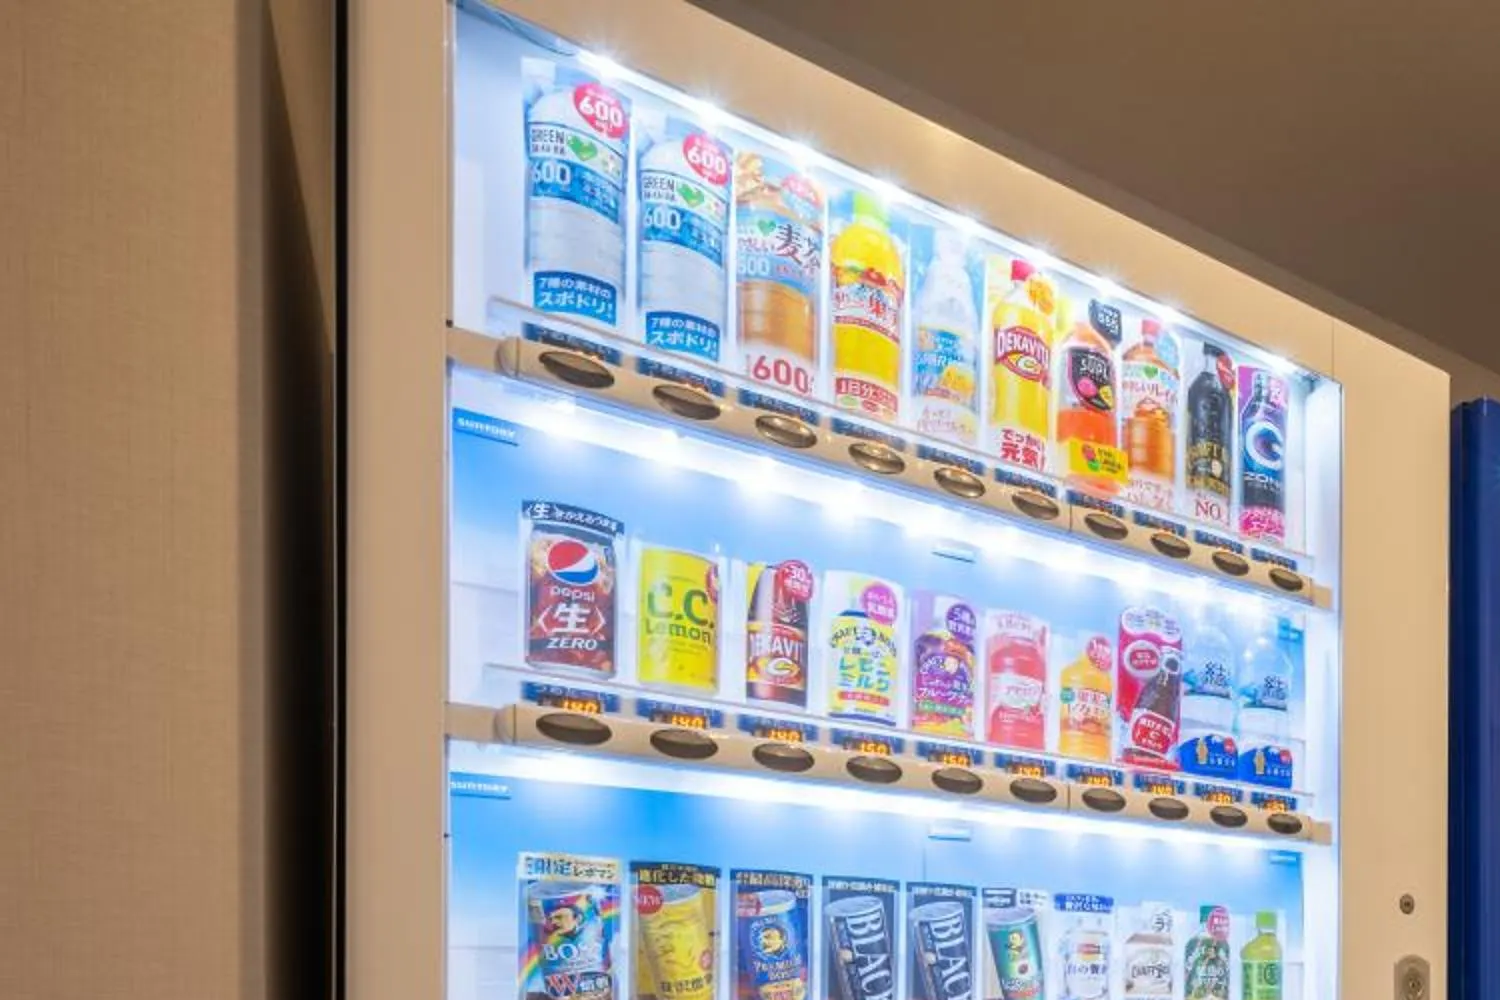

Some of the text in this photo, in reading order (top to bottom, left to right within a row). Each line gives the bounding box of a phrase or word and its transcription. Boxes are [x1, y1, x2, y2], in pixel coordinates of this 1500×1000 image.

[579, 96, 623, 127] 600
[687, 147, 728, 173] 600
[753, 355, 808, 394] 600
[550, 586, 595, 602] pepsi
[646, 617, 711, 643] Lemon
[547, 637, 598, 651] ZERO
